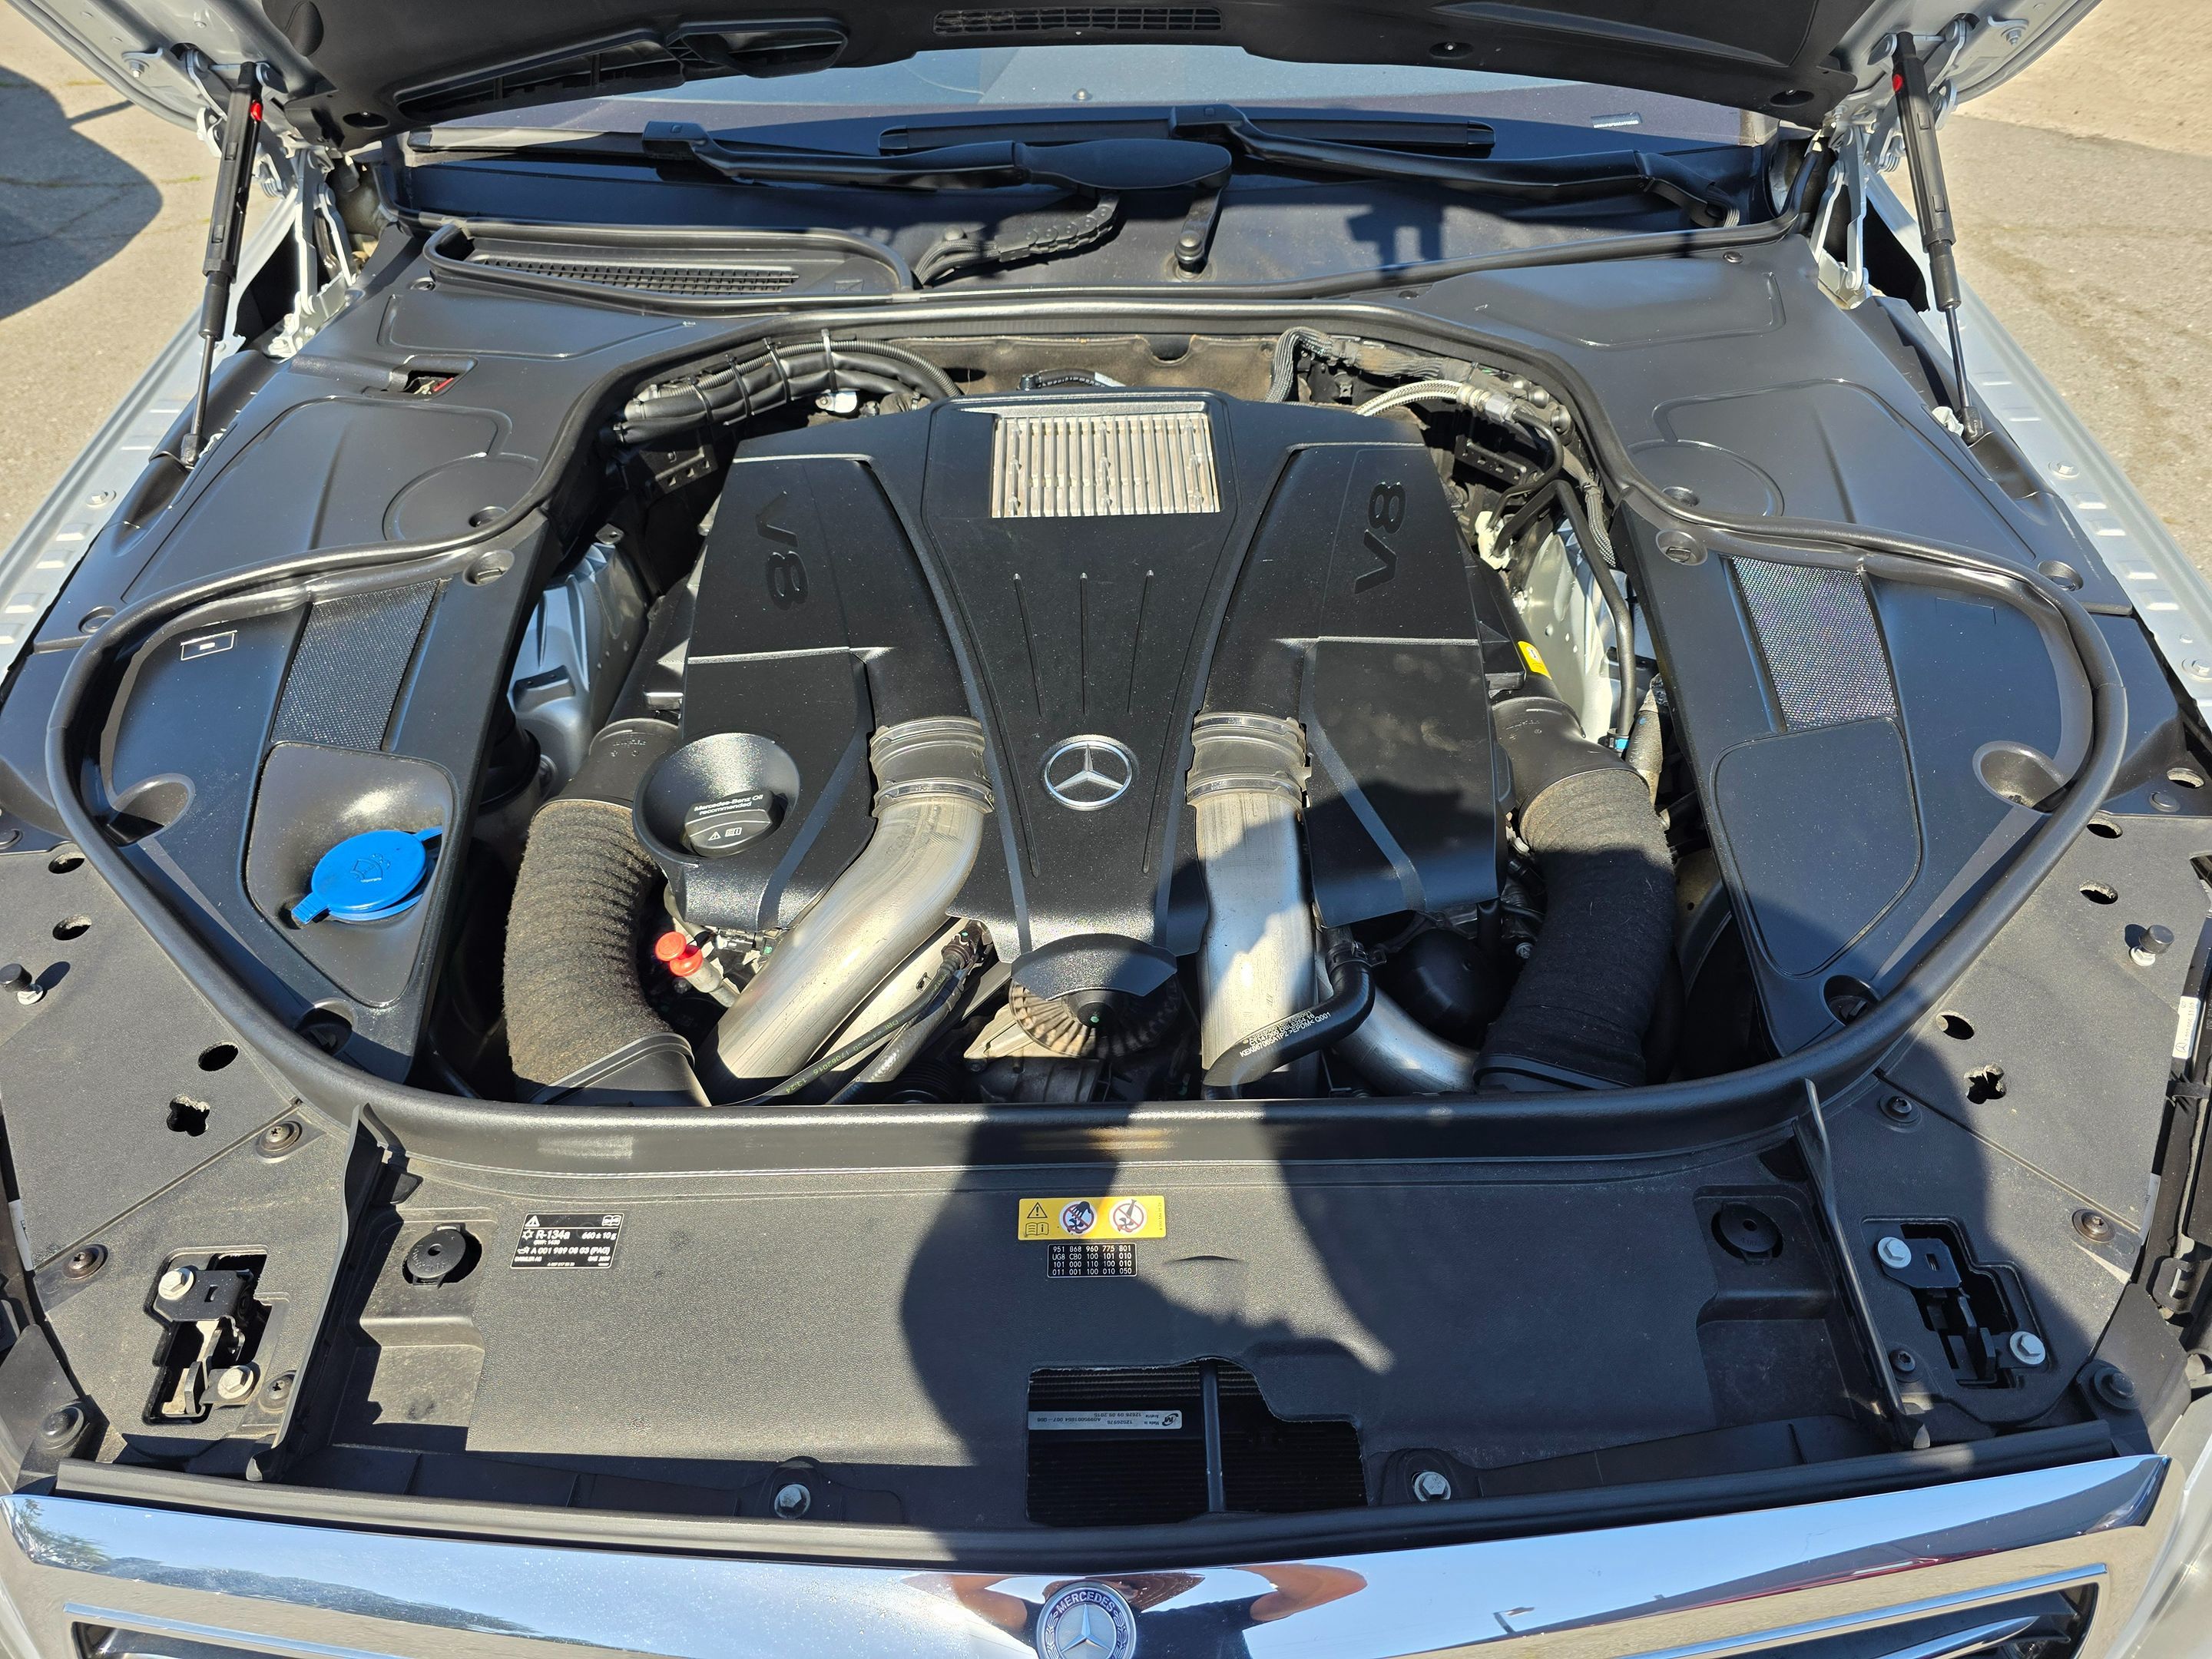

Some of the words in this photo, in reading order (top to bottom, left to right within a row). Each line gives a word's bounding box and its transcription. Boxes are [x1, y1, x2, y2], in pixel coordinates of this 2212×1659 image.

[1354, 482, 1407, 595] V8
[756, 490, 809, 611] V8
[694, 796, 751, 812] Mercedes-Benz
[700, 801, 752, 816] recommended
[786, 1078, 807, 1094] 13:24
[535, 1230, 570, 1240] R-134a
[1056, 1591, 1114, 1613] MERCEDES
